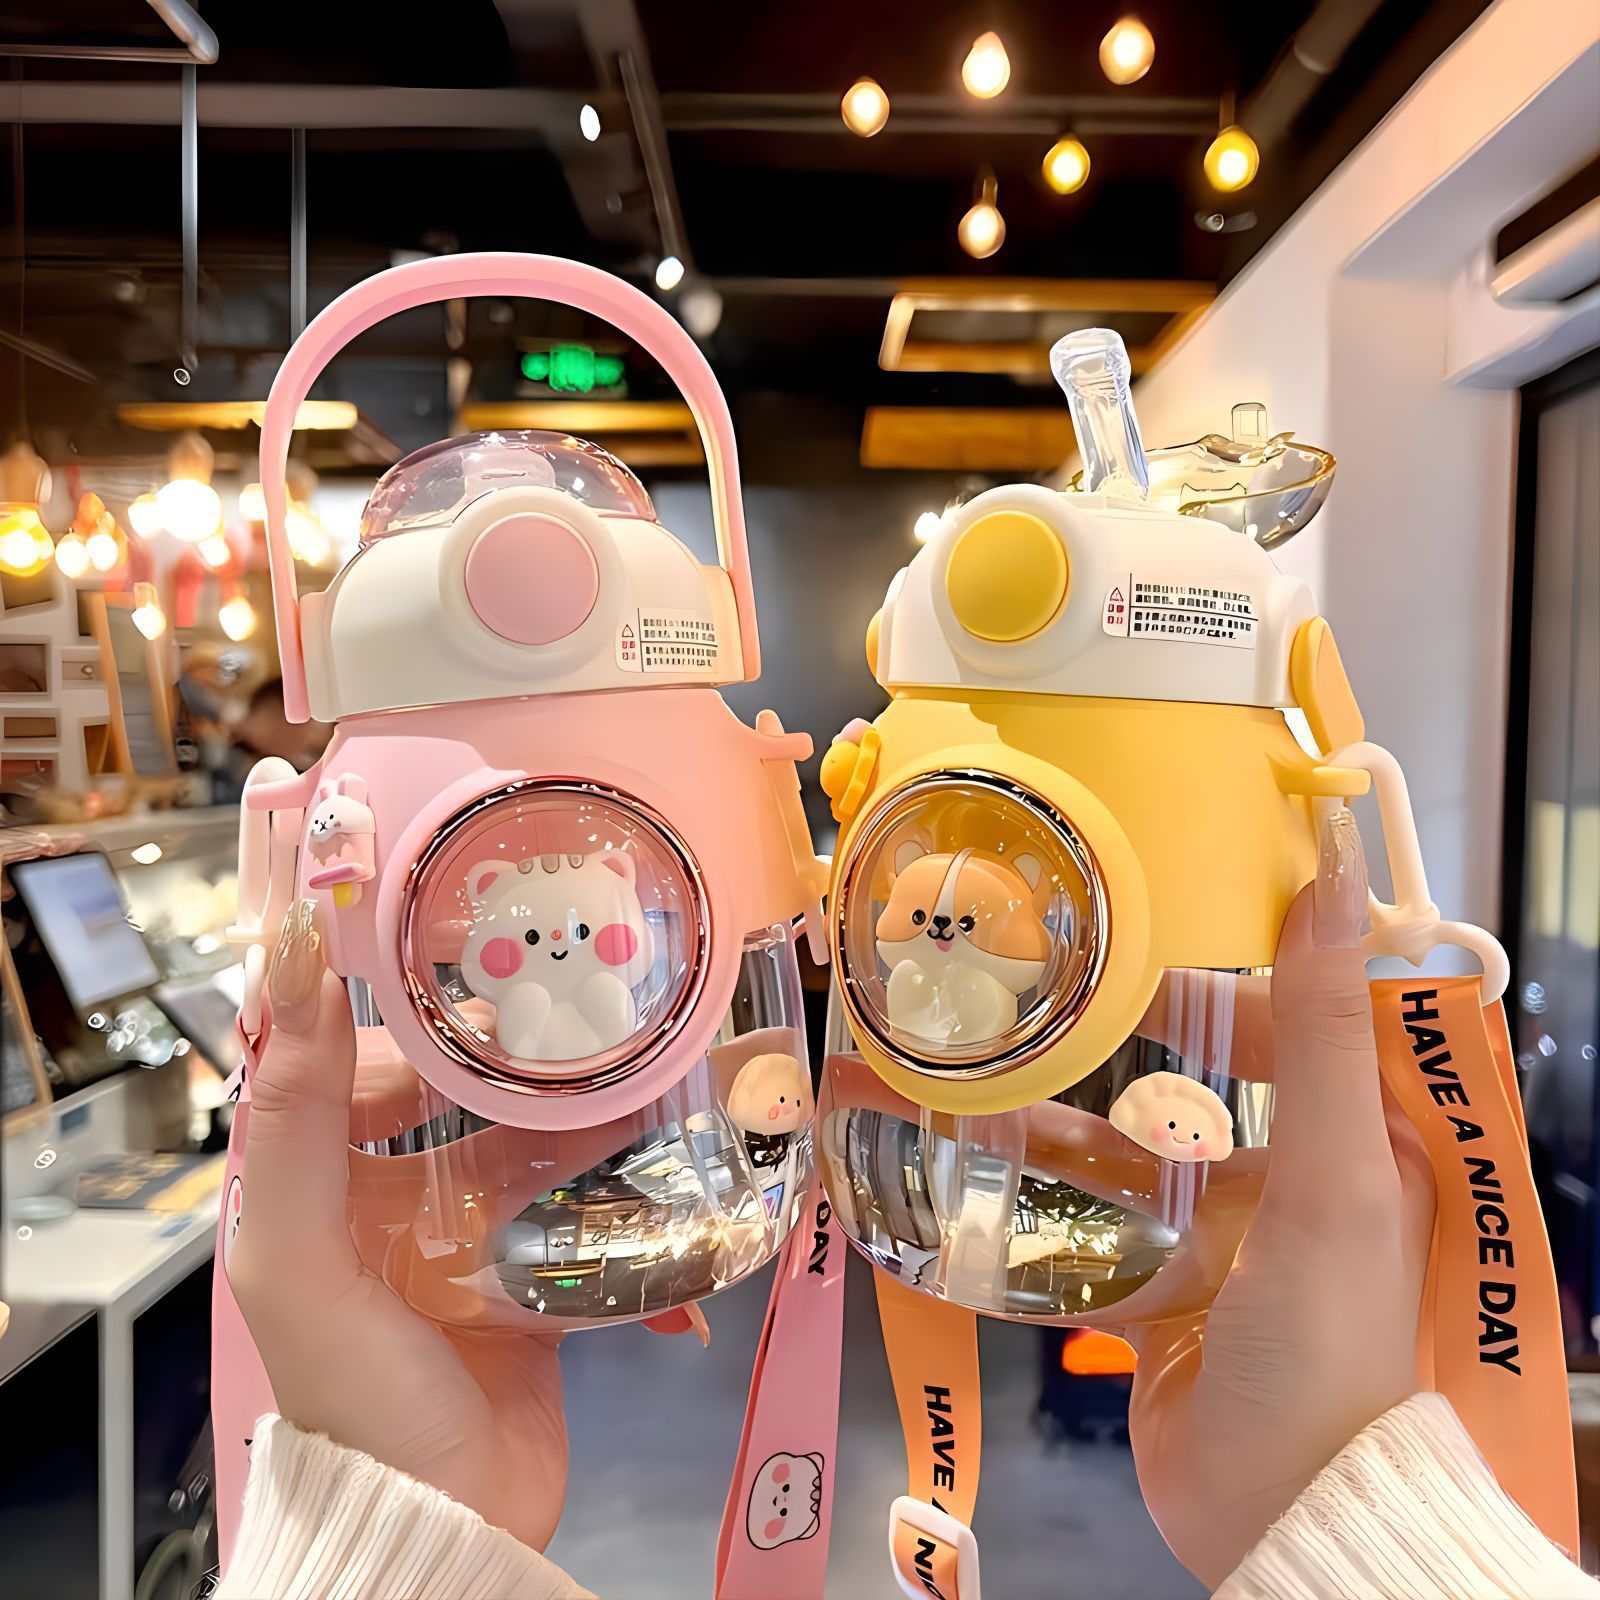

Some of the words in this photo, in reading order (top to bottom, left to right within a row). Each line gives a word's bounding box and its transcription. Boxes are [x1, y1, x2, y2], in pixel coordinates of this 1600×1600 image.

[1402, 989, 1470, 1107] HAVE
[1446, 1115, 1485, 1143] A
[808, 1200, 832, 1276] DAY
[1463, 1157, 1515, 1269] NICE
[1479, 1281, 1522, 1377] DAY
[924, 1385, 955, 1492] HAVE
